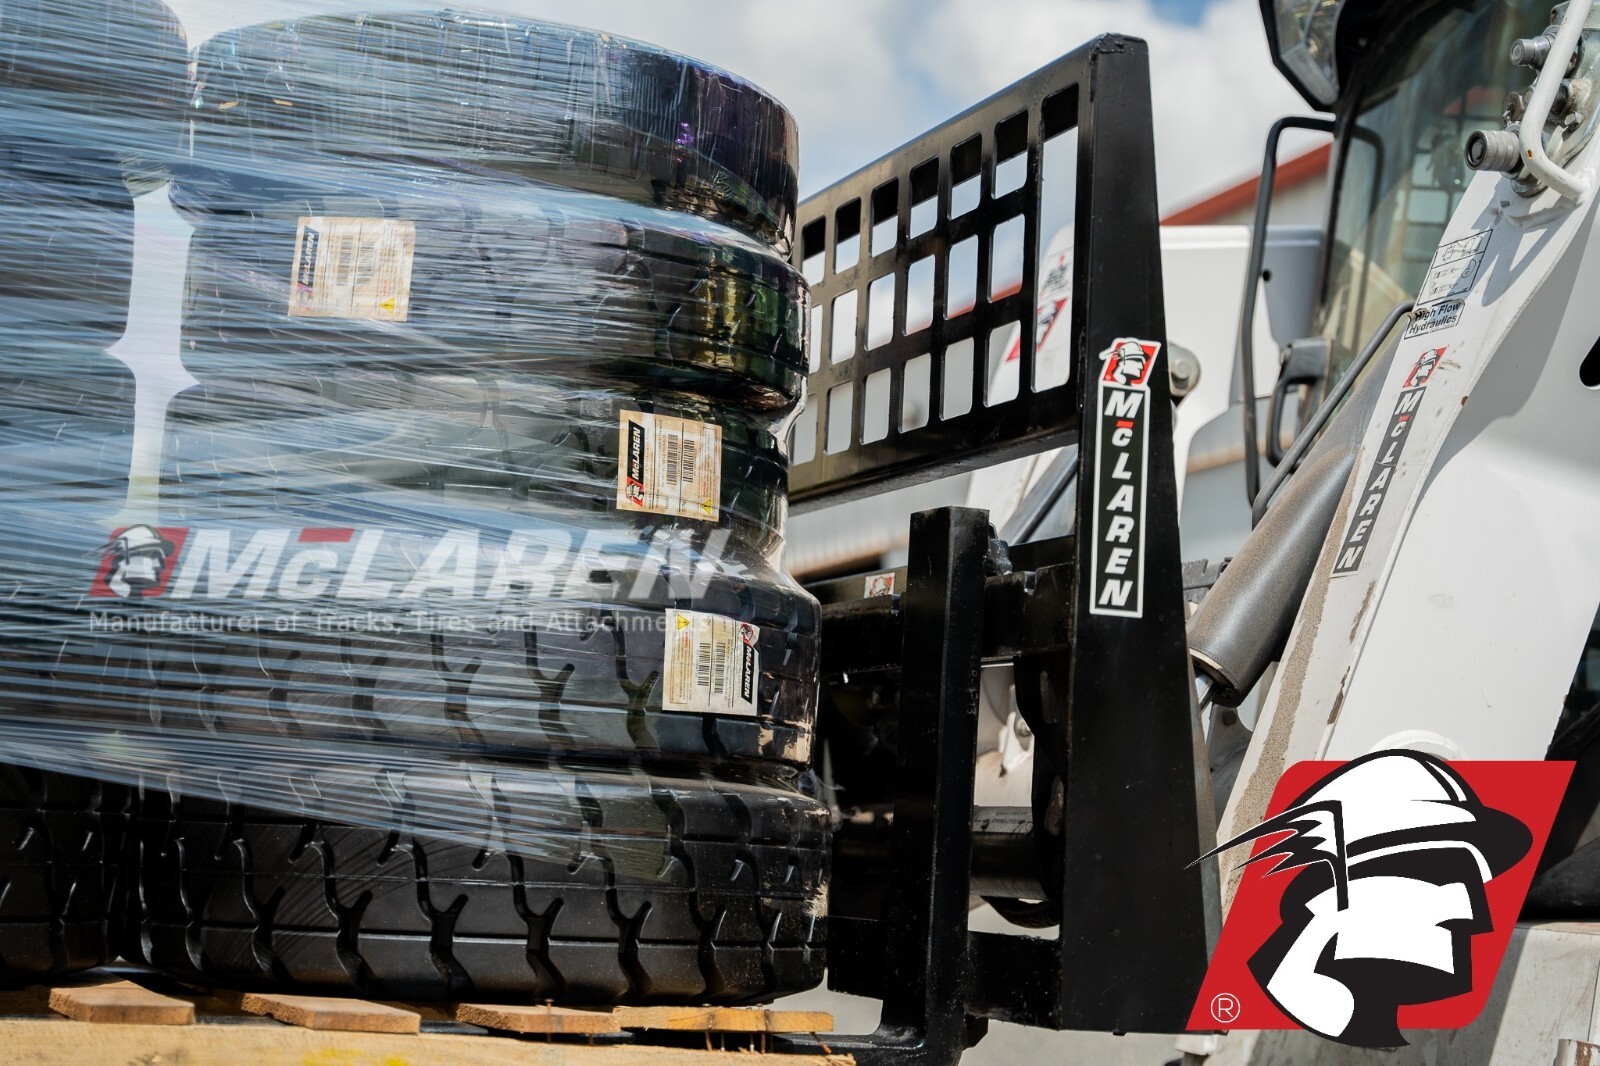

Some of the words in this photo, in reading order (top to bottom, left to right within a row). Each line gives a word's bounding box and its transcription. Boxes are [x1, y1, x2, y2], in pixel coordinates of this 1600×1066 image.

[302, 232, 315, 285] McLAREN
[1409, 315, 1457, 334] Hydraulics
[1415, 308, 1437, 321] High
[1438, 302, 1461, 315] Flow
[631, 427, 641, 480] McLAREN
[1336, 389, 1424, 570] McLAREN
[1099, 390, 1143, 607] McLAREN
[743, 645, 752, 698] McLAREN
